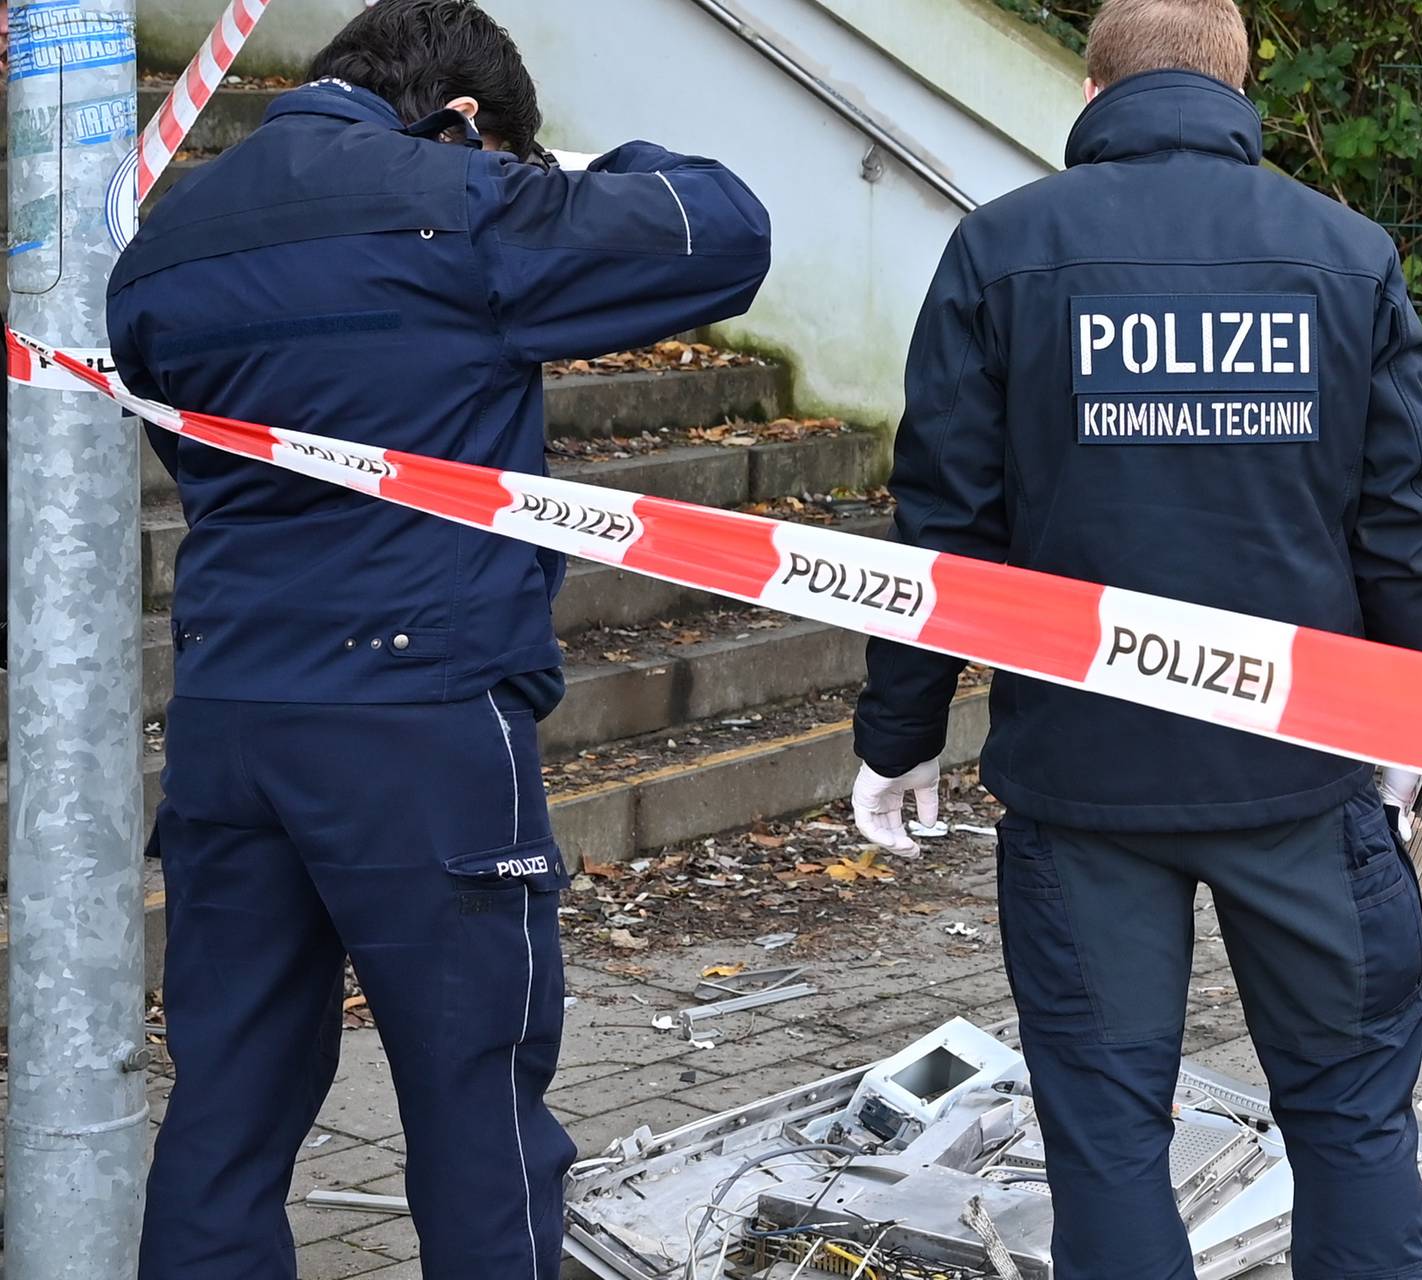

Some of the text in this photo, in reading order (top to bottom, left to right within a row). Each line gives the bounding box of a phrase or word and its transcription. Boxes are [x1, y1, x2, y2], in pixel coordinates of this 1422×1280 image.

[1079, 312, 1310, 375] POLIZEI
[1084, 402, 1313, 436] KRIMINALTECHNIK
[511, 492, 635, 543] POLIZEI
[782, 552, 924, 618] POLIZEI
[1106, 626, 1275, 704] POLIZEI
